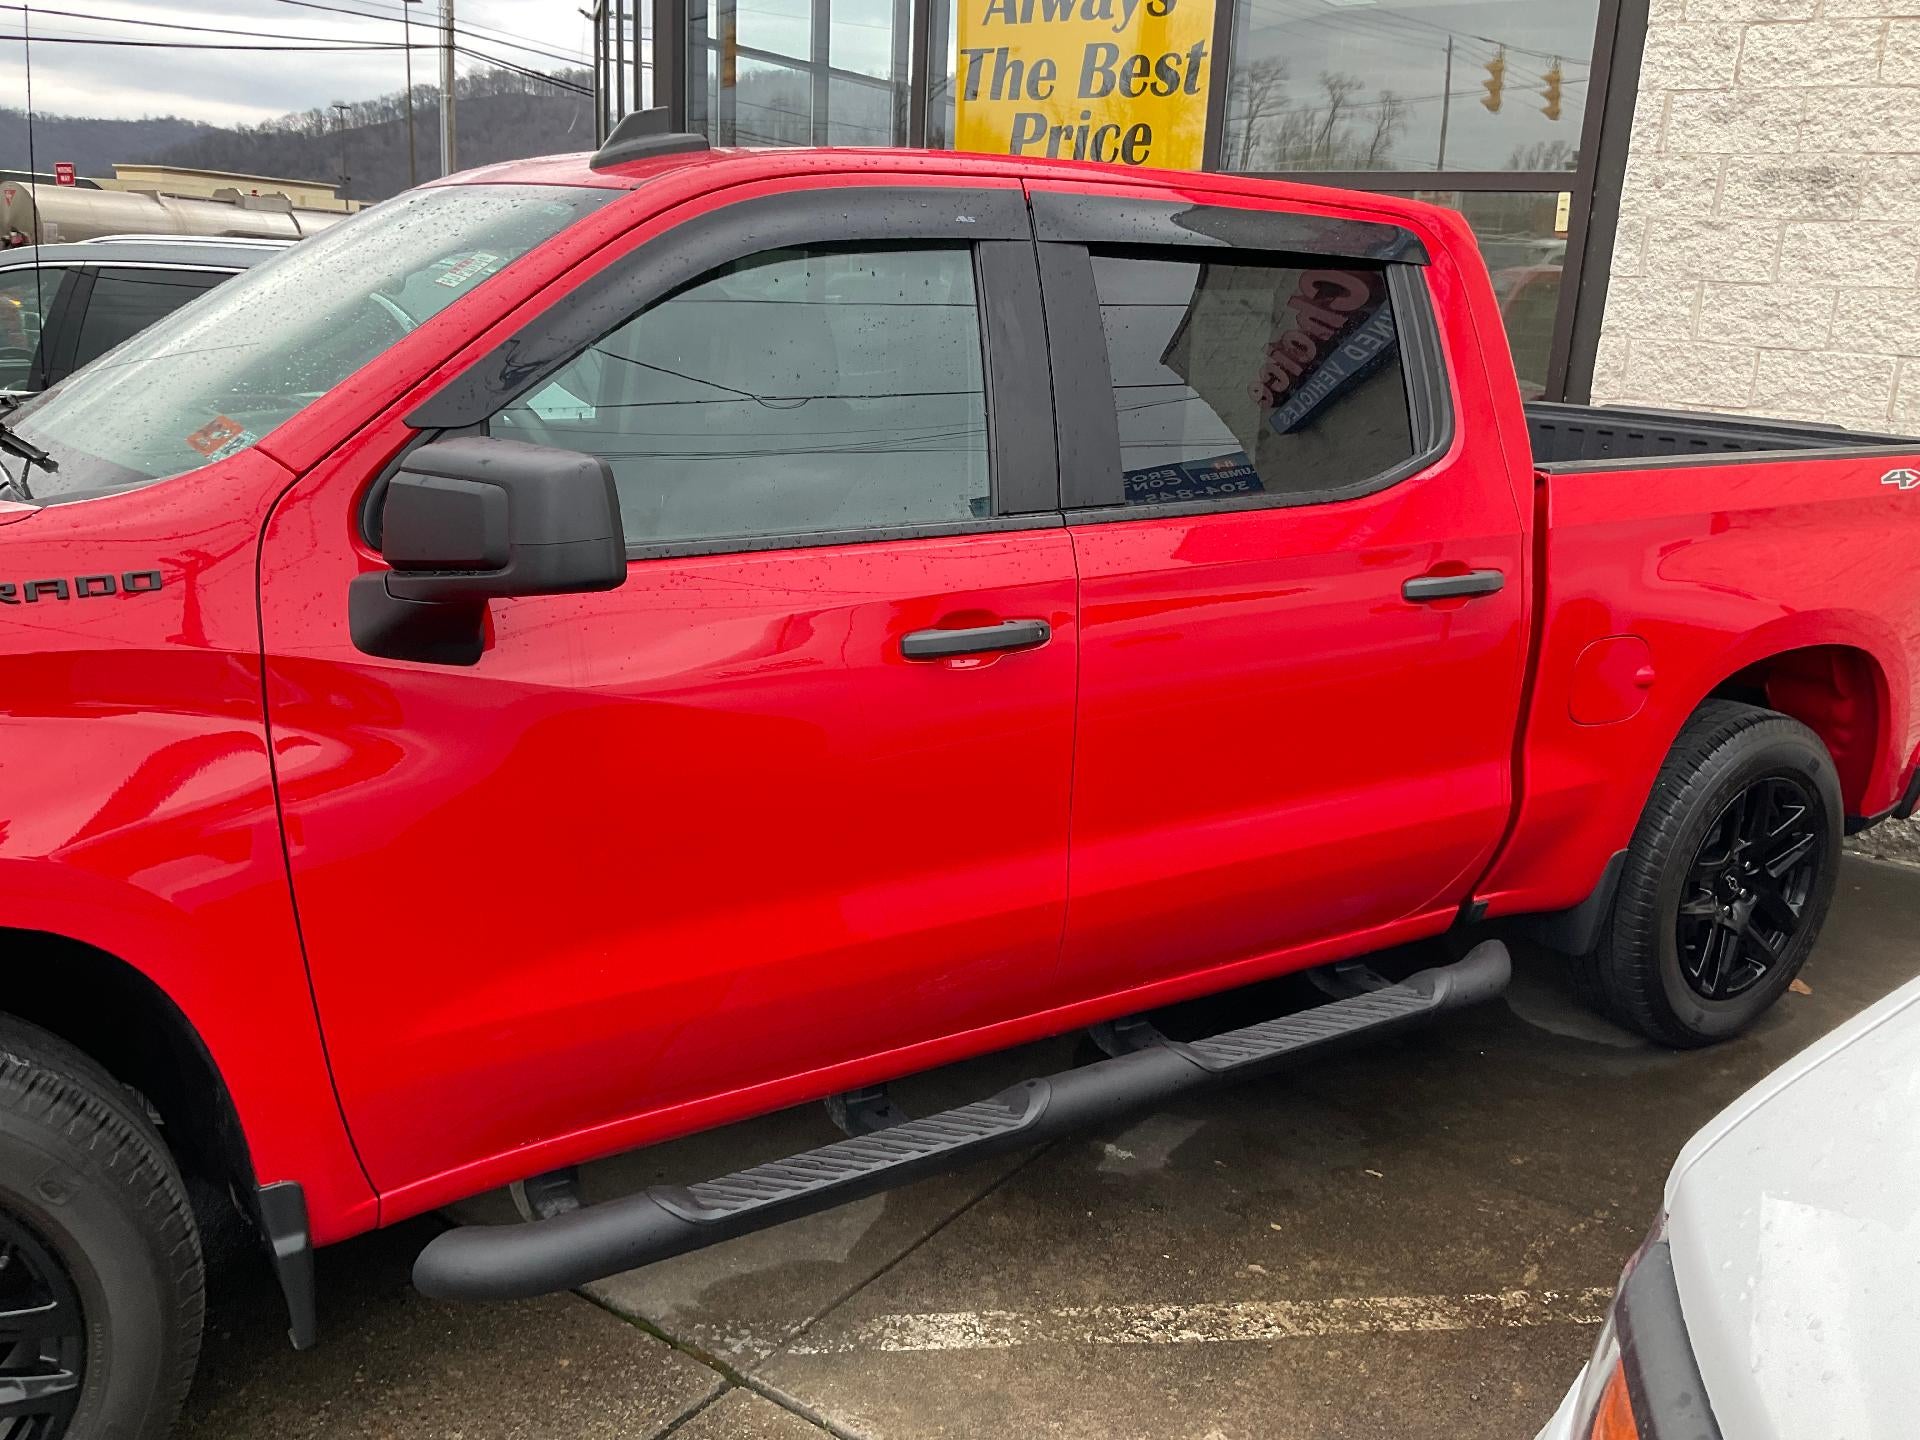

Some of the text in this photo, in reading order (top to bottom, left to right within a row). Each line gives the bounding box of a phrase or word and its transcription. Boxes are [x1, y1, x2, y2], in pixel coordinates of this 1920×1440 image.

[961, 39, 1209, 101] The Best
[1009, 109, 1153, 165] Price
